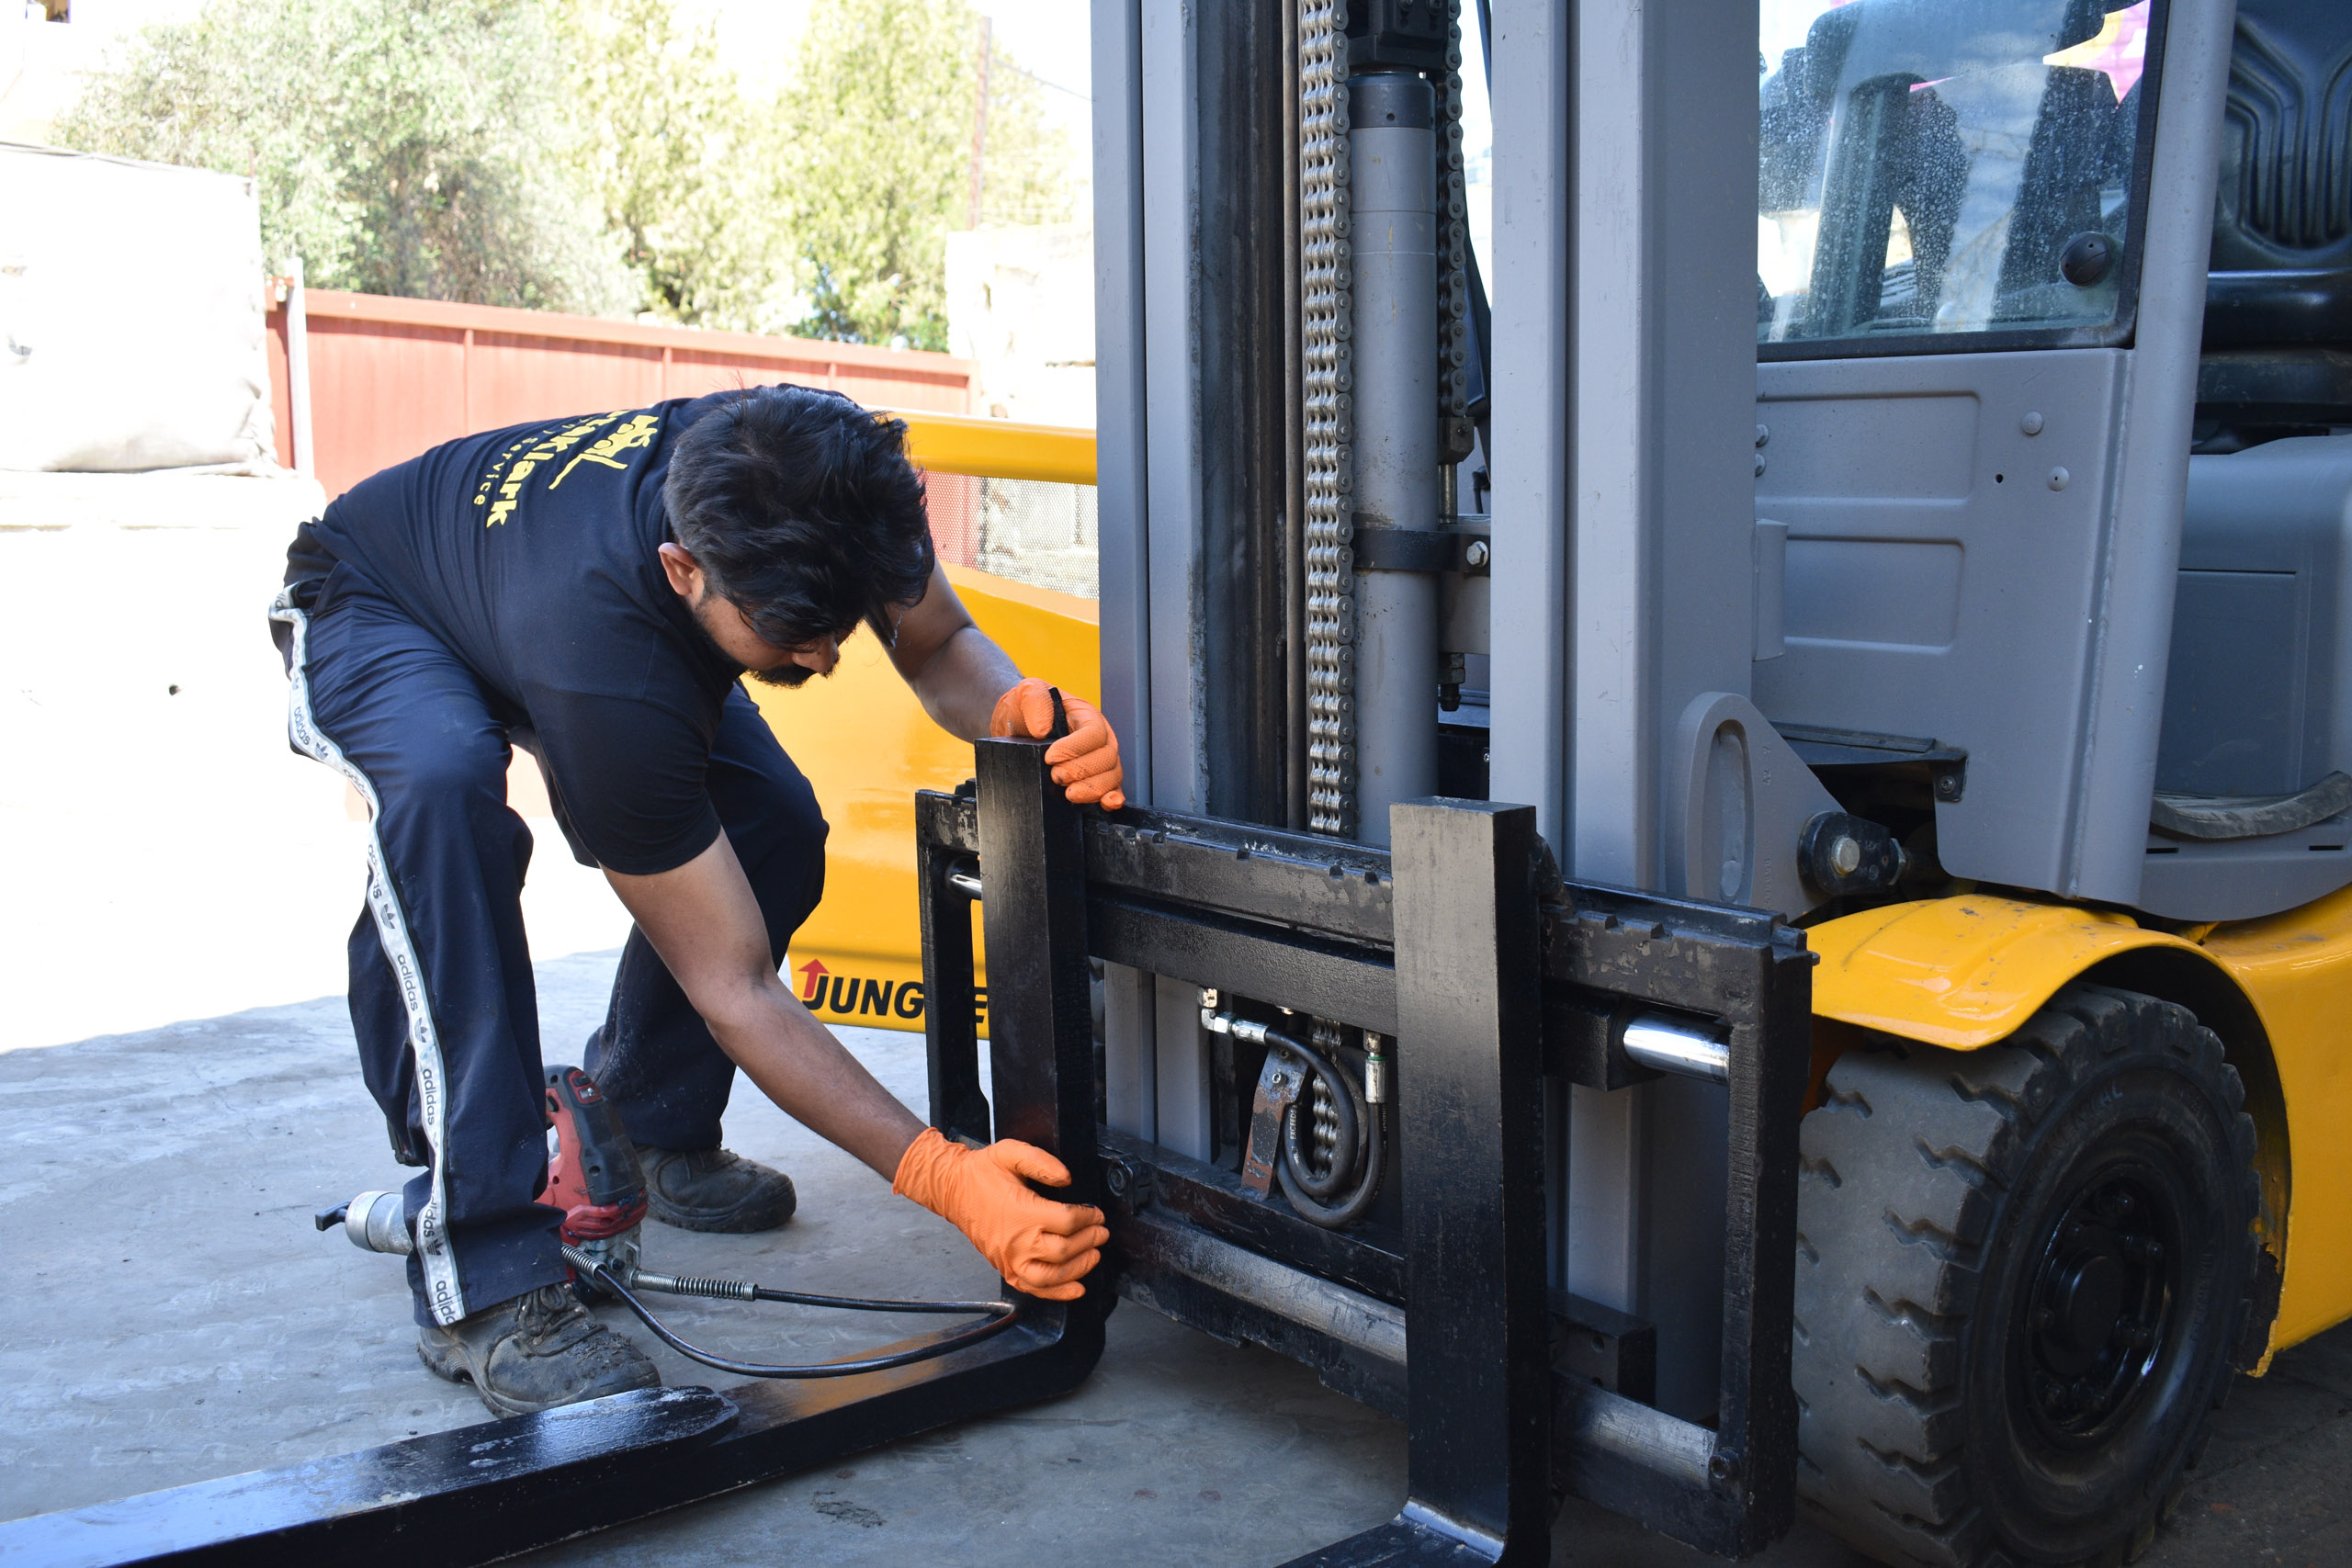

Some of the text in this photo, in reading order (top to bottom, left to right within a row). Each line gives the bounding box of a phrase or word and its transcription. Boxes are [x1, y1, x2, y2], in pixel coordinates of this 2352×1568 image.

[472, 437, 538, 505] service
[294, 706, 311, 745] adidas
[368, 843, 382, 899] adas
[397, 953, 418, 1011] adidas
[423, 1068, 437, 1126] adidas
[1289, 1108, 1297, 1140] EXCEEDS
[435, 1280, 456, 1325] adida
